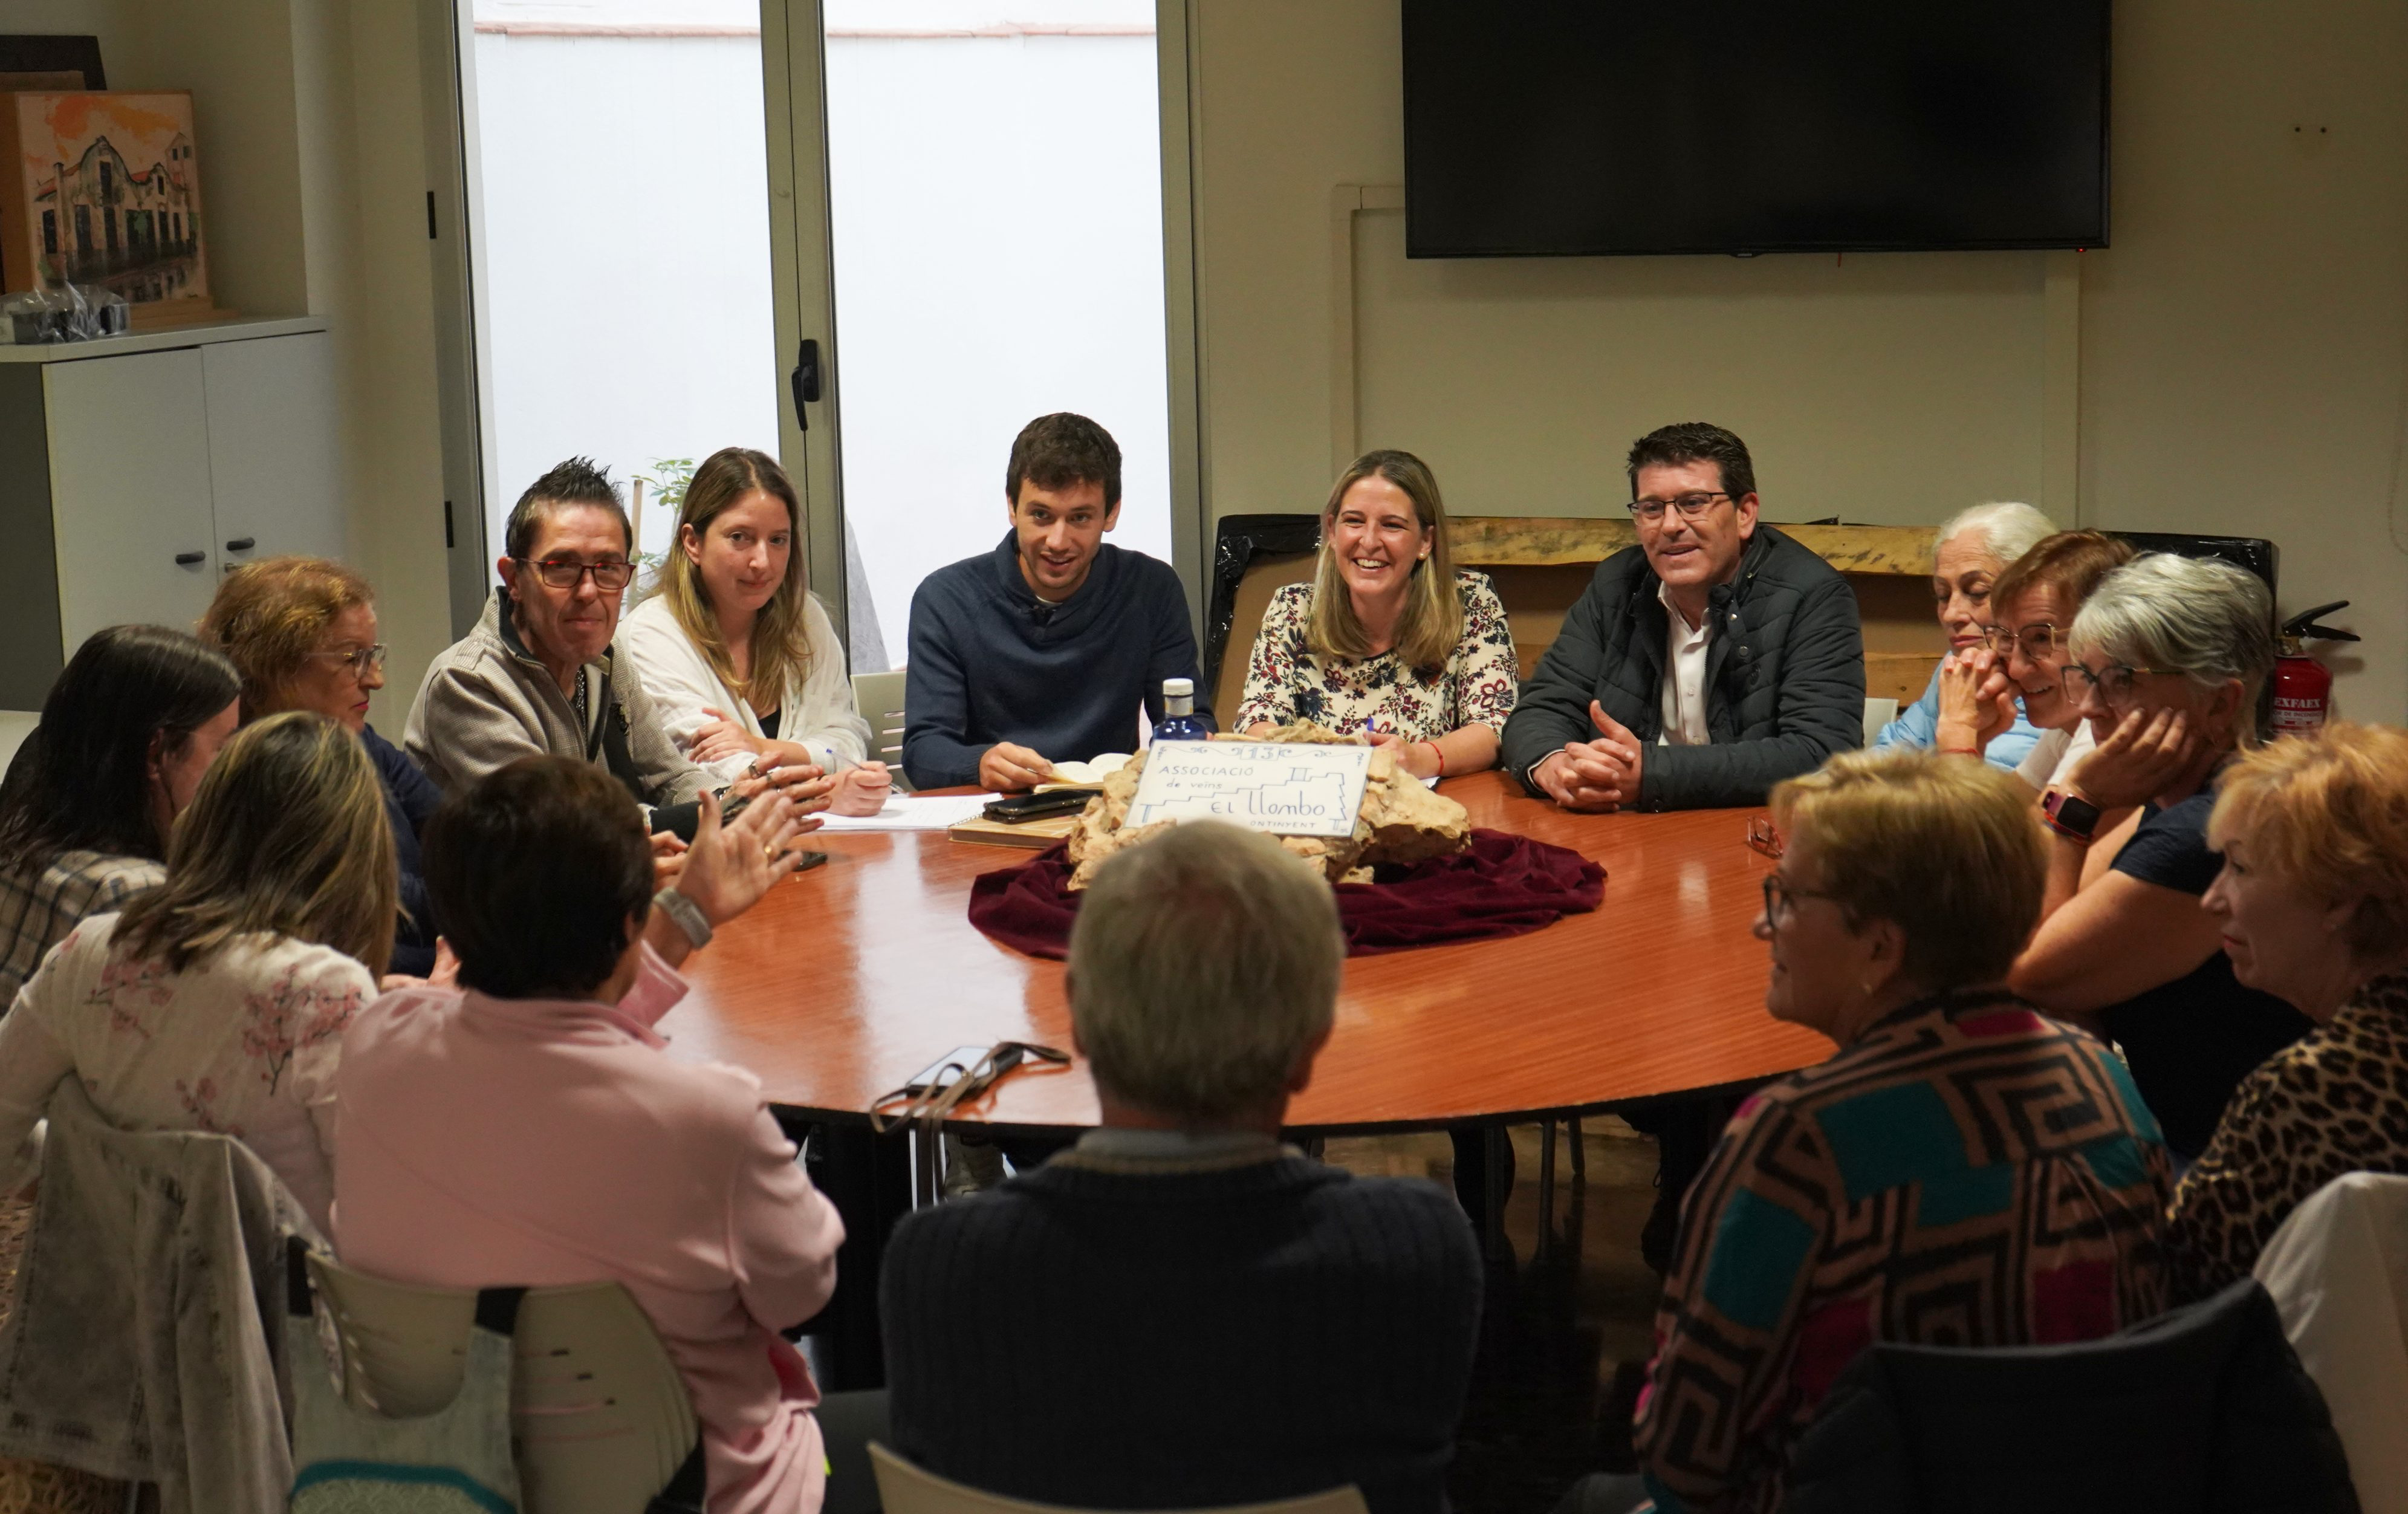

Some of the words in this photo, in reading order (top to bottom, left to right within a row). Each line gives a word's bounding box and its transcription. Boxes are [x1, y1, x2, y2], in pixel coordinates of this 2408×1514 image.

[1248, 747, 1274, 759] 13
[1158, 765, 1254, 776] ASSOCIACIÓ
[1166, 778, 1180, 788] de
[1248, 790, 1325, 816] llombo
[1250, 820, 1316, 828] ONTINYENT
